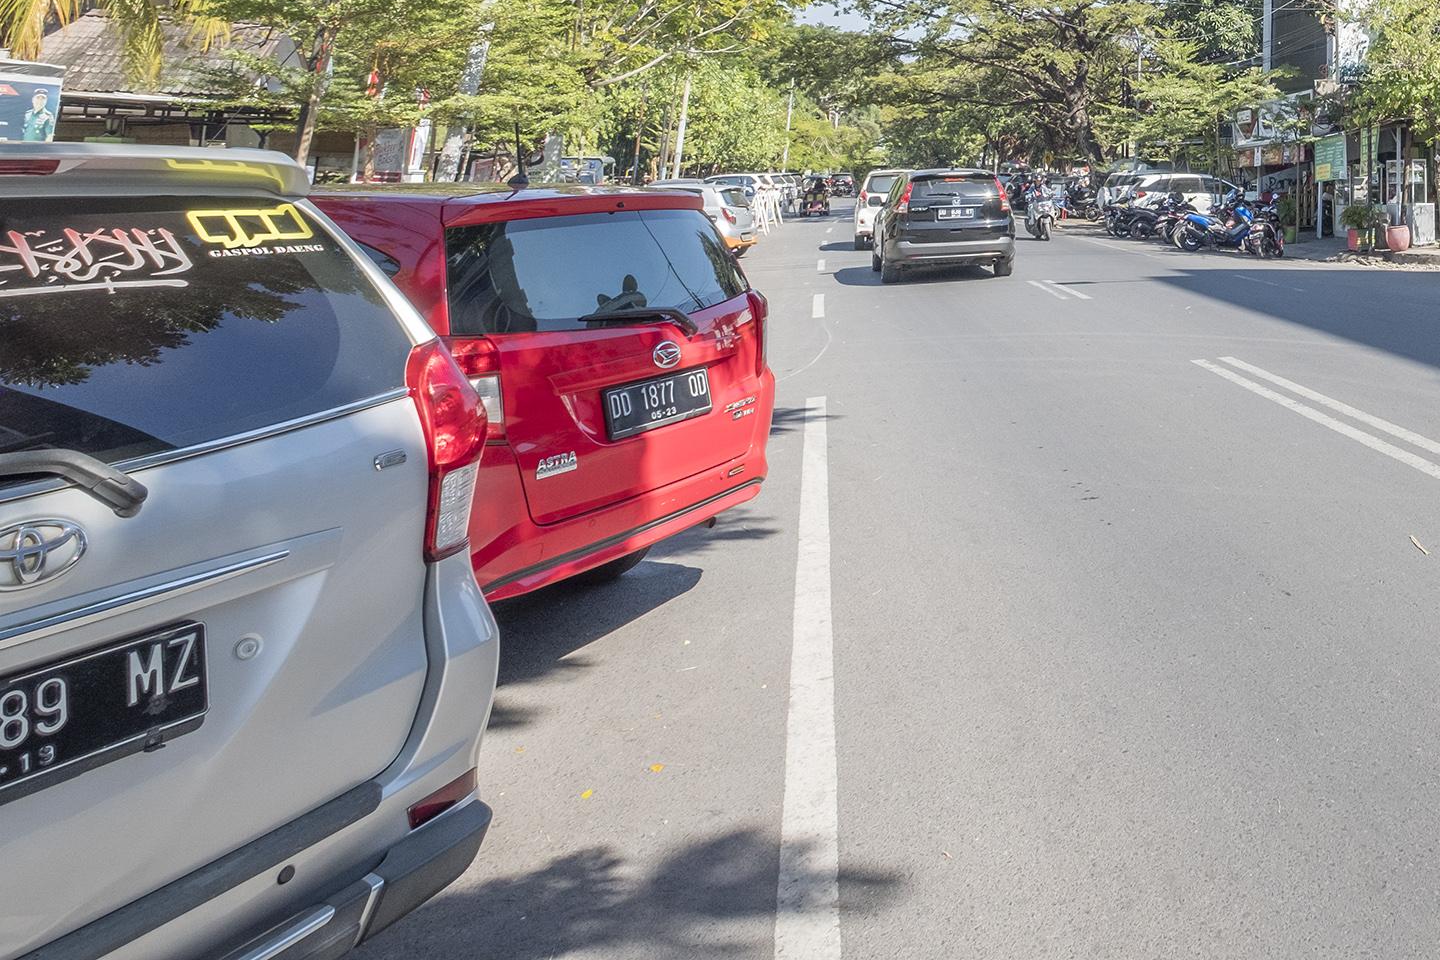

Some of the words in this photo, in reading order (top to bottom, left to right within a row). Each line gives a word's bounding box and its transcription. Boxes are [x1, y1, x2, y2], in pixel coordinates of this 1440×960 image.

[208, 246, 273, 258] GASPOL
[273, 244, 325, 254] DAENG
[610, 393, 632, 419] DD
[640, 380, 675, 411] 1877
[688, 373, 707, 397] QD
[651, 406, 677, 419] 05-23
[537, 451, 577, 471] ASTRA
[127, 632, 200, 708] MZ
